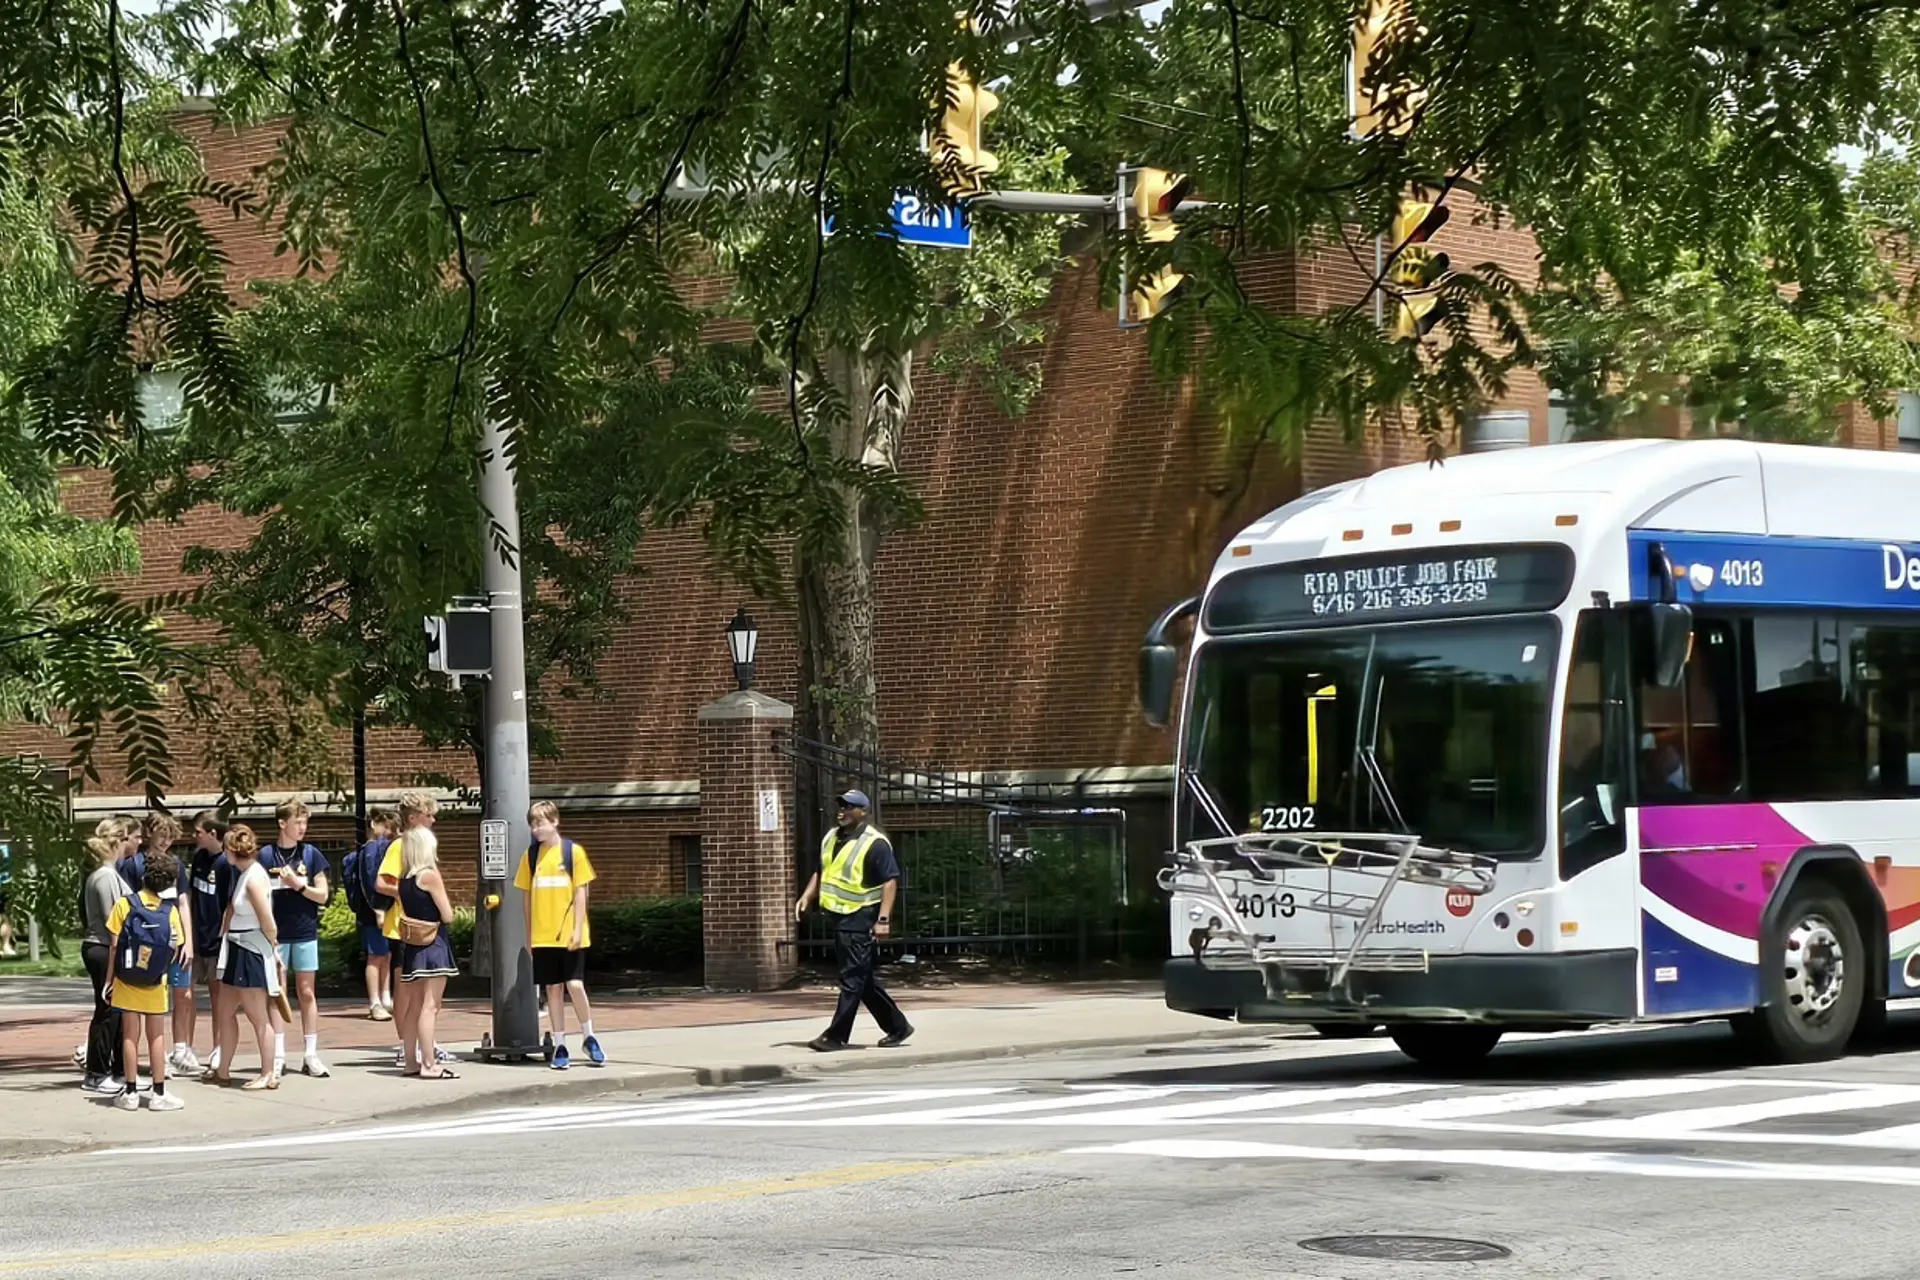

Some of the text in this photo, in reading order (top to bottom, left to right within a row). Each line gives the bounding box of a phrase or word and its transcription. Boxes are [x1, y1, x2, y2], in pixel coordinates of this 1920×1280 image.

[1304, 557, 1497, 595] RTA POLICE JOB FAIR
[1720, 560, 1763, 587] 4013
[1262, 807, 1316, 830] 2202
[1235, 893, 1296, 918] 4013
